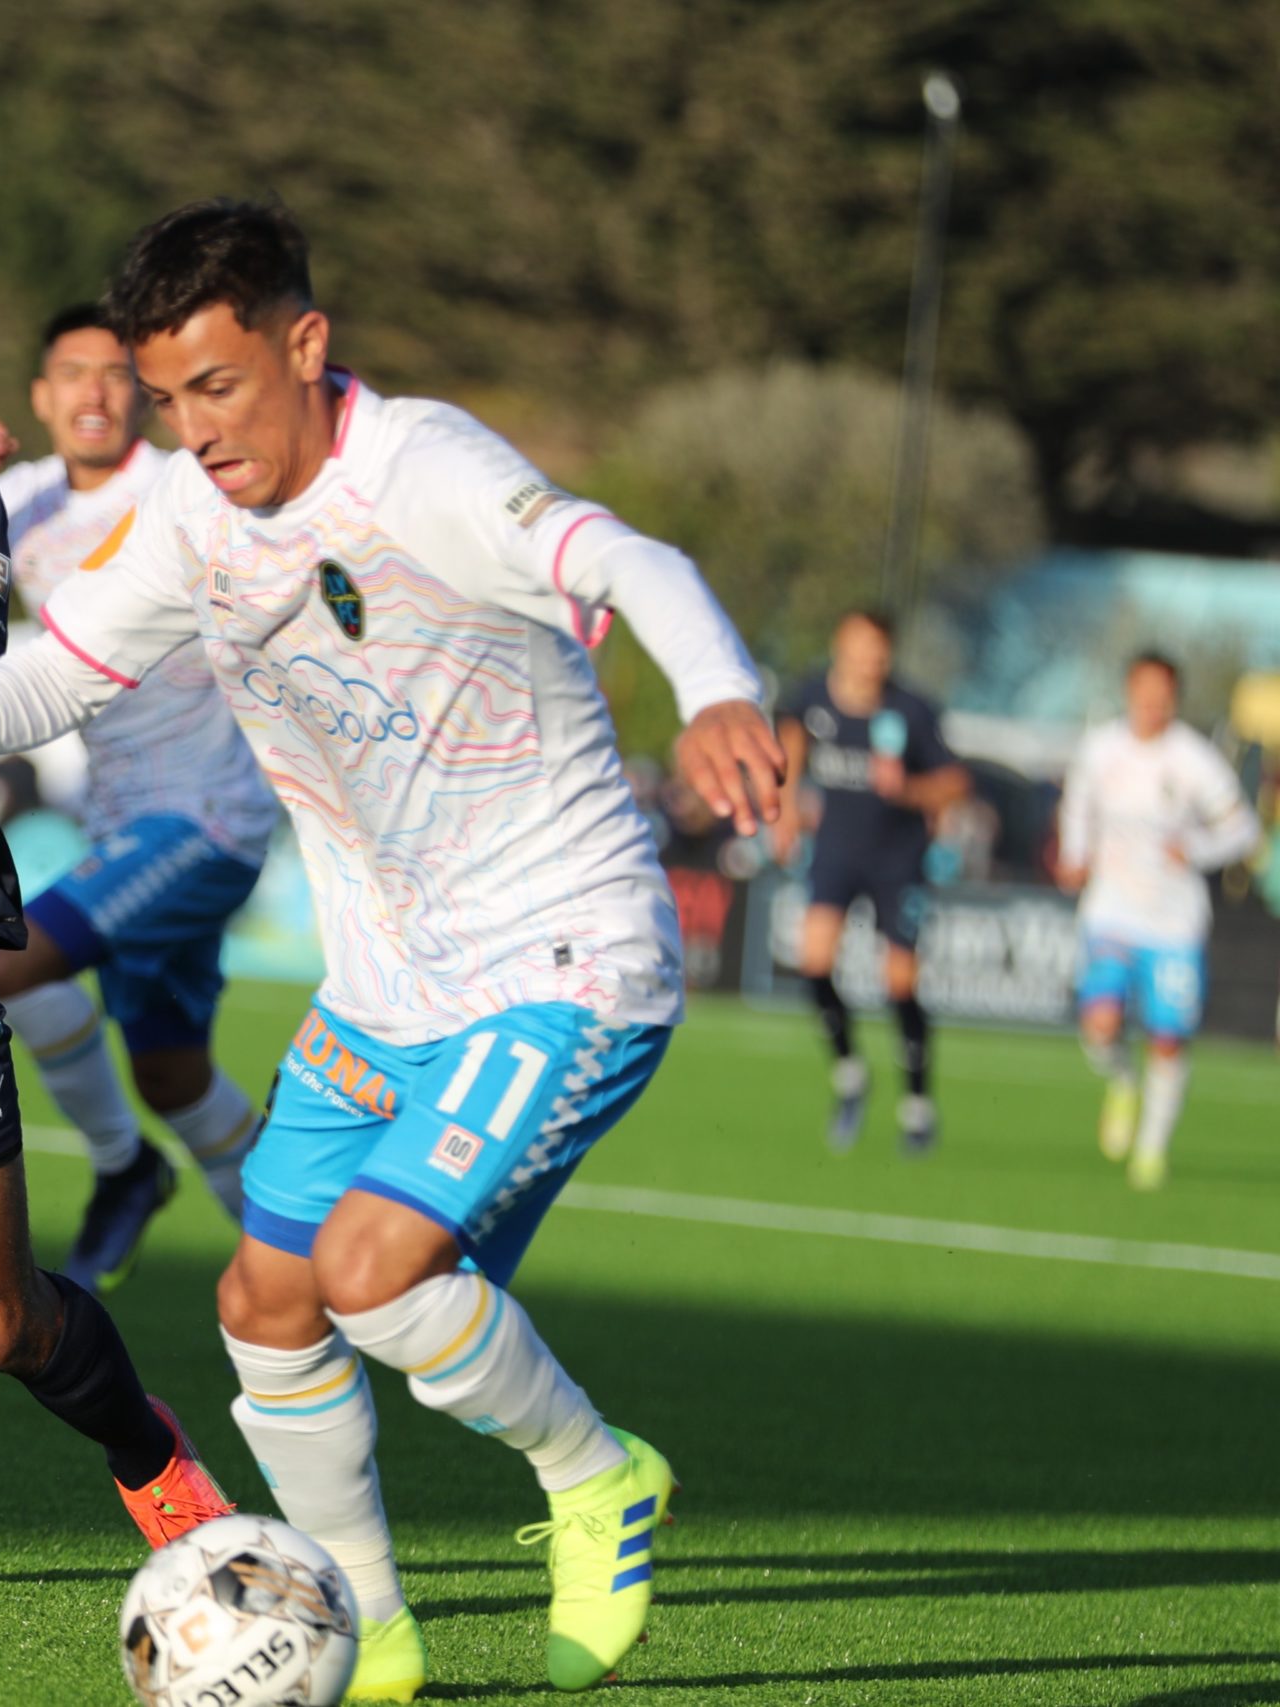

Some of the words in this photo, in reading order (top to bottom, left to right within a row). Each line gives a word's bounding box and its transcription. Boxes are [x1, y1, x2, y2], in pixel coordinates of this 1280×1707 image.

[301, 1070, 324, 1094] the
[324, 1086, 365, 1118] Power
[435, 1031, 548, 1142] 11
[182, 1629, 295, 1707] SELEC
